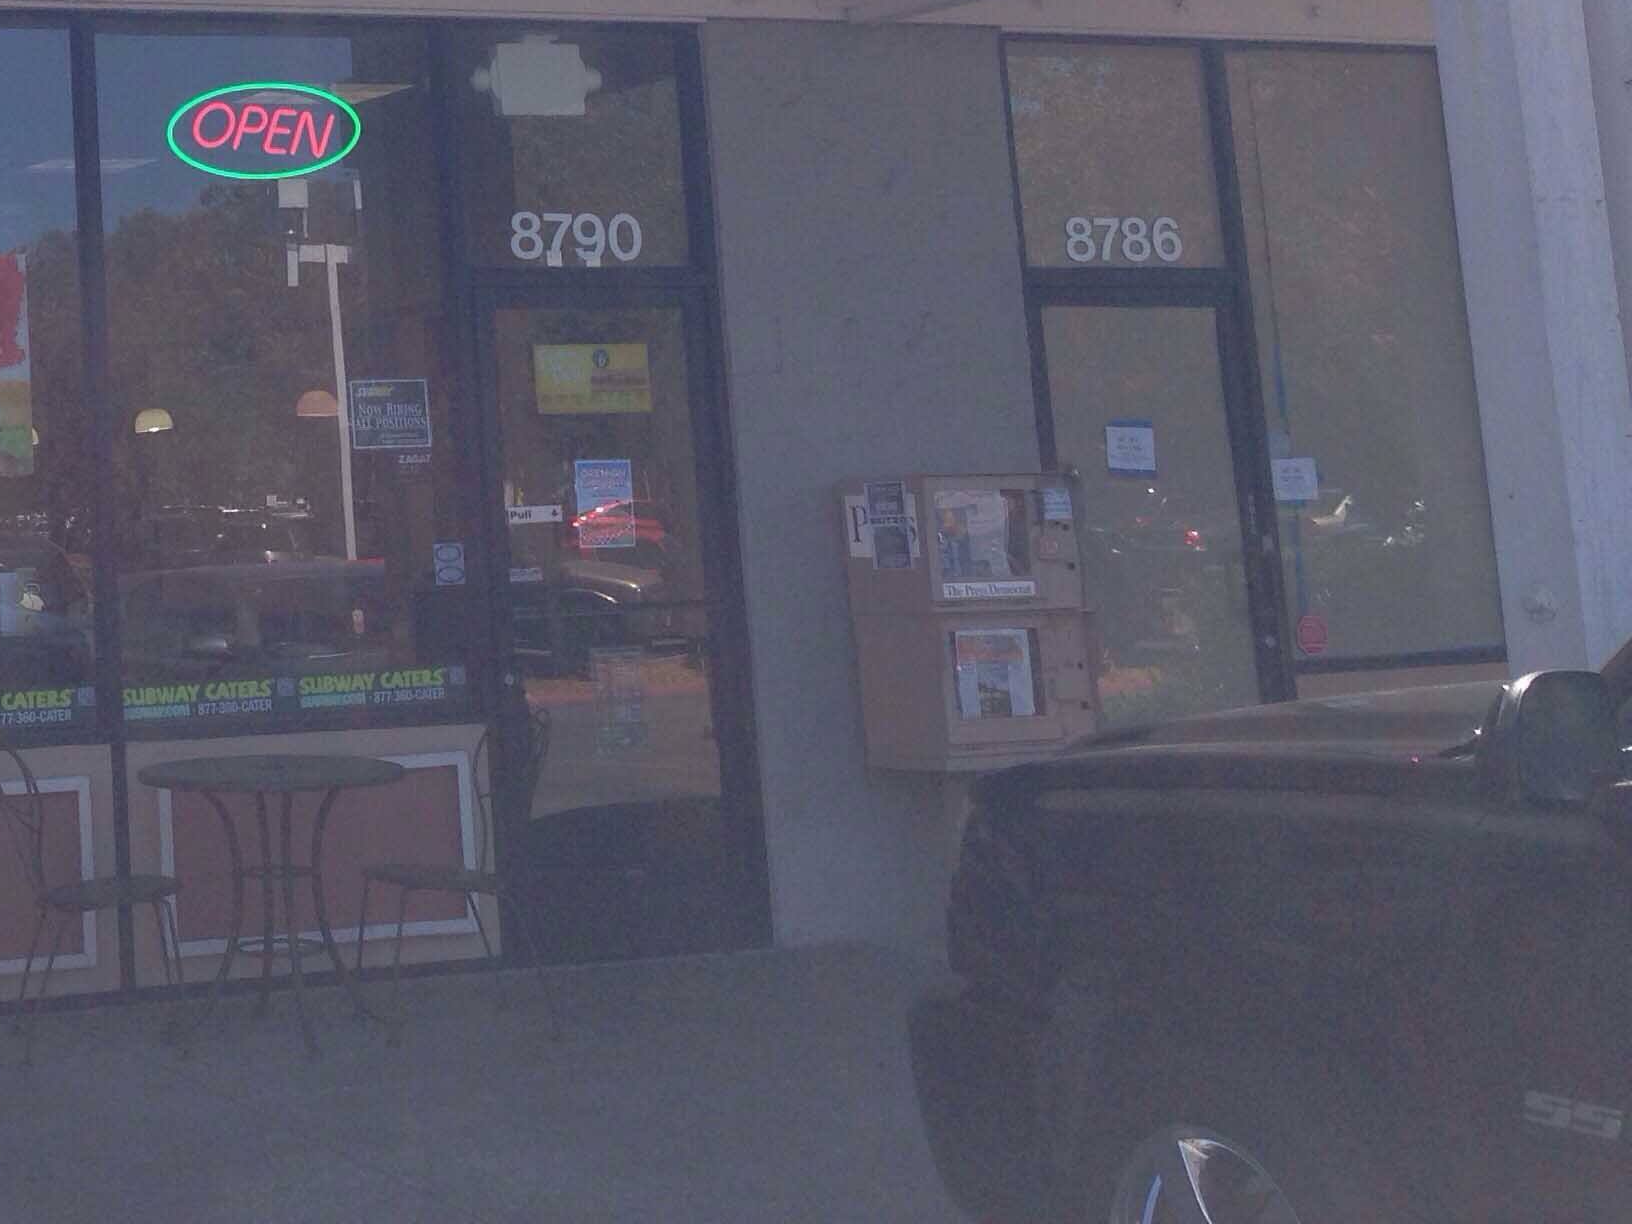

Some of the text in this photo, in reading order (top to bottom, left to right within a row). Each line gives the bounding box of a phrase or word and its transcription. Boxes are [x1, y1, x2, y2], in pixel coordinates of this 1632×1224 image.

[192, 101, 335, 158] OPEN
[510, 211, 642, 261] 8790
[1065, 215, 1183, 262] 8786
[509, 509, 532, 520] Pull
[122, 679, 272, 706] SUBWAY CATERS
[299, 668, 444, 695] SUBWAY CATERS
[1, 688, 72, 710] CATERS
